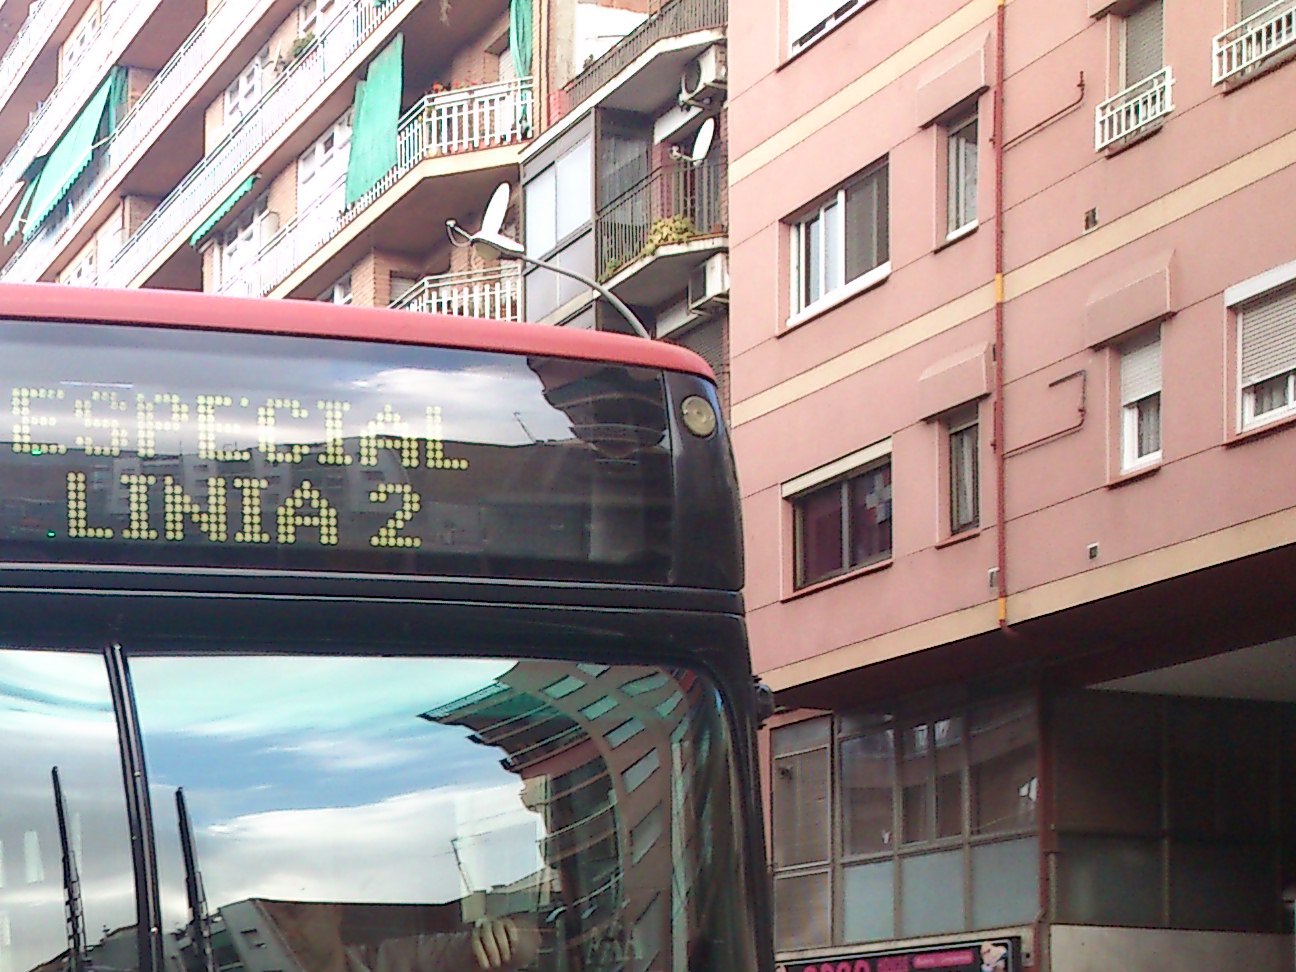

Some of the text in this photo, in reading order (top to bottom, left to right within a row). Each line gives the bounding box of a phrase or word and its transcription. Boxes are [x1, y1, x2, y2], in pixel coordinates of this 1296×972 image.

[11, 386, 470, 471] ESPECIAL
[65, 470, 423, 549] LINIA 2
